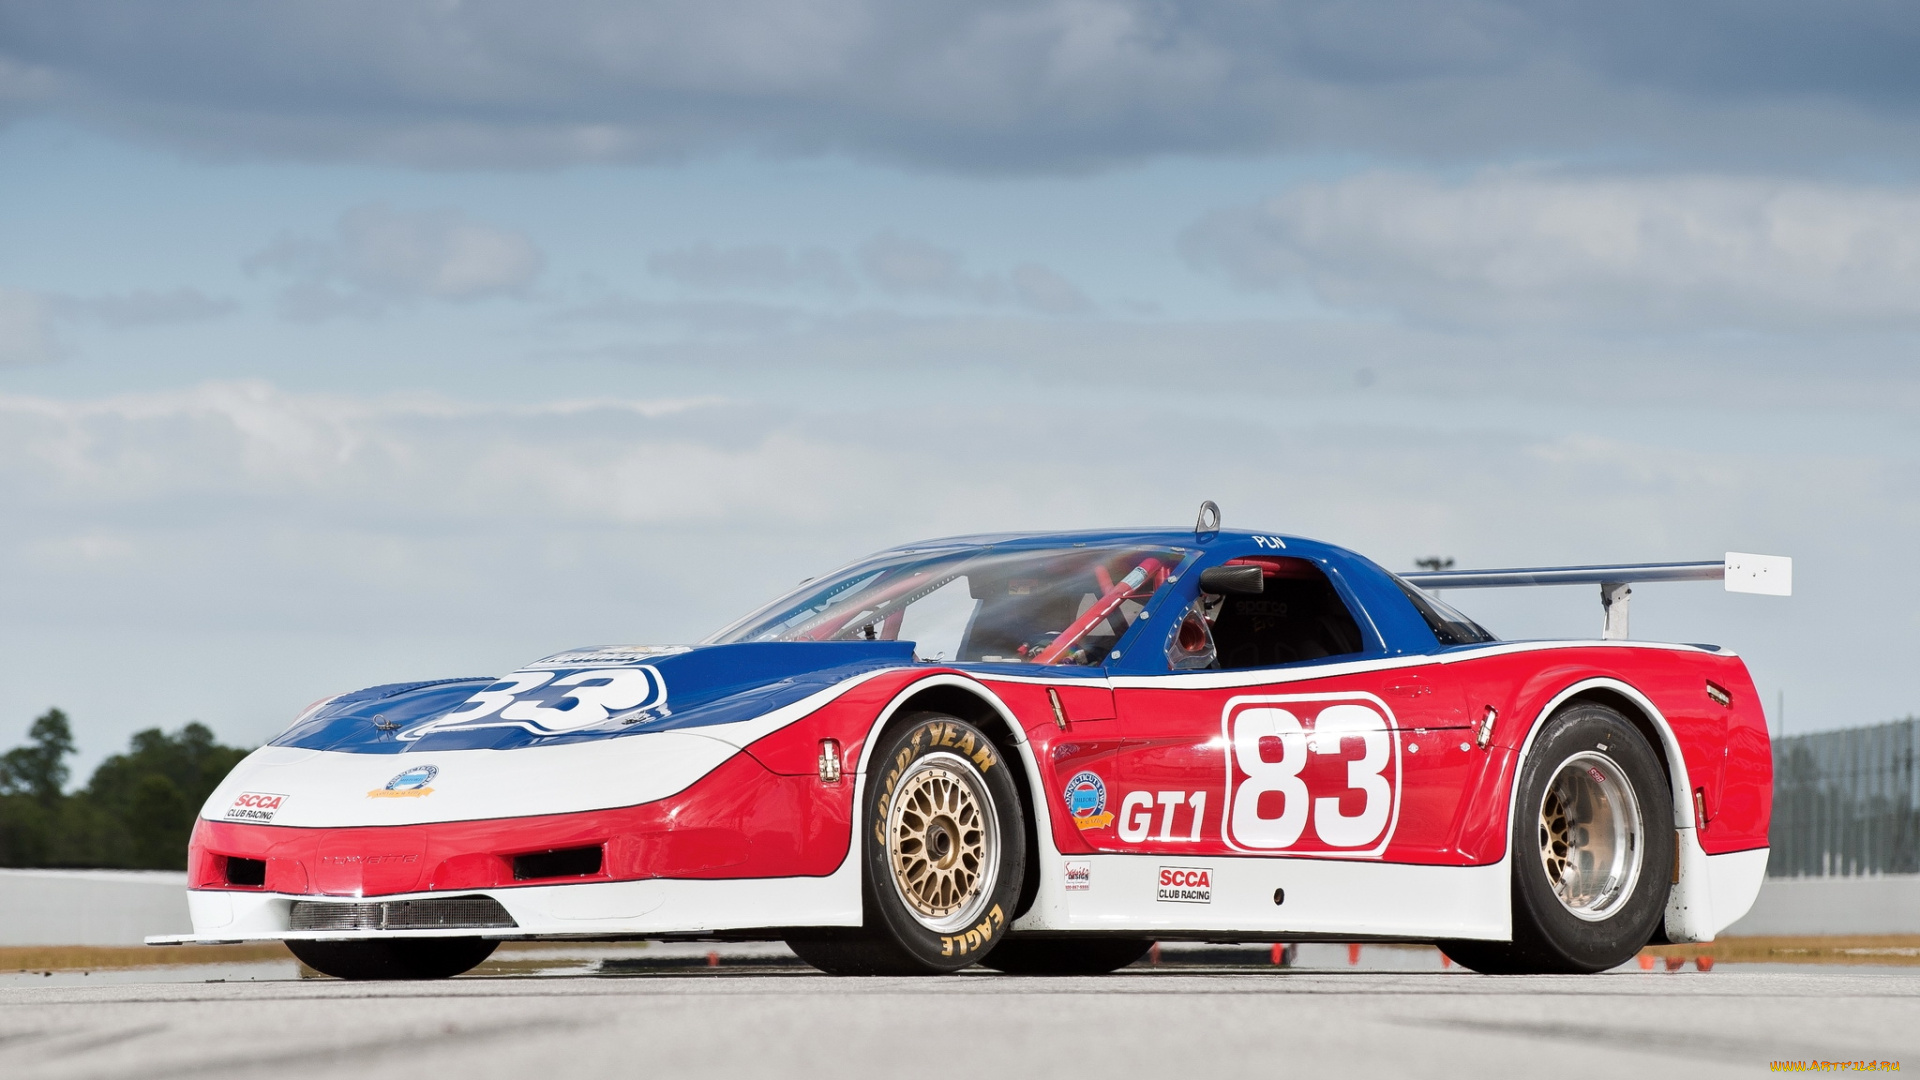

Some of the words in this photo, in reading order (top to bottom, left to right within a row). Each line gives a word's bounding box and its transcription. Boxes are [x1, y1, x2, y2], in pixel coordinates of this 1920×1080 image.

[1251, 535, 1287, 549] PLN
[1231, 704, 1392, 849] 83
[234, 794, 282, 810] SCCA
[227, 809, 247, 817] CLUB
[246, 810, 274, 820] RACING
[1117, 791, 1207, 843] GT1
[1160, 869, 1210, 888] SCCA
[1159, 889, 1180, 899] CLUB
[1181, 890, 1210, 900] RACING
[940, 903, 1005, 957] EAGLE
